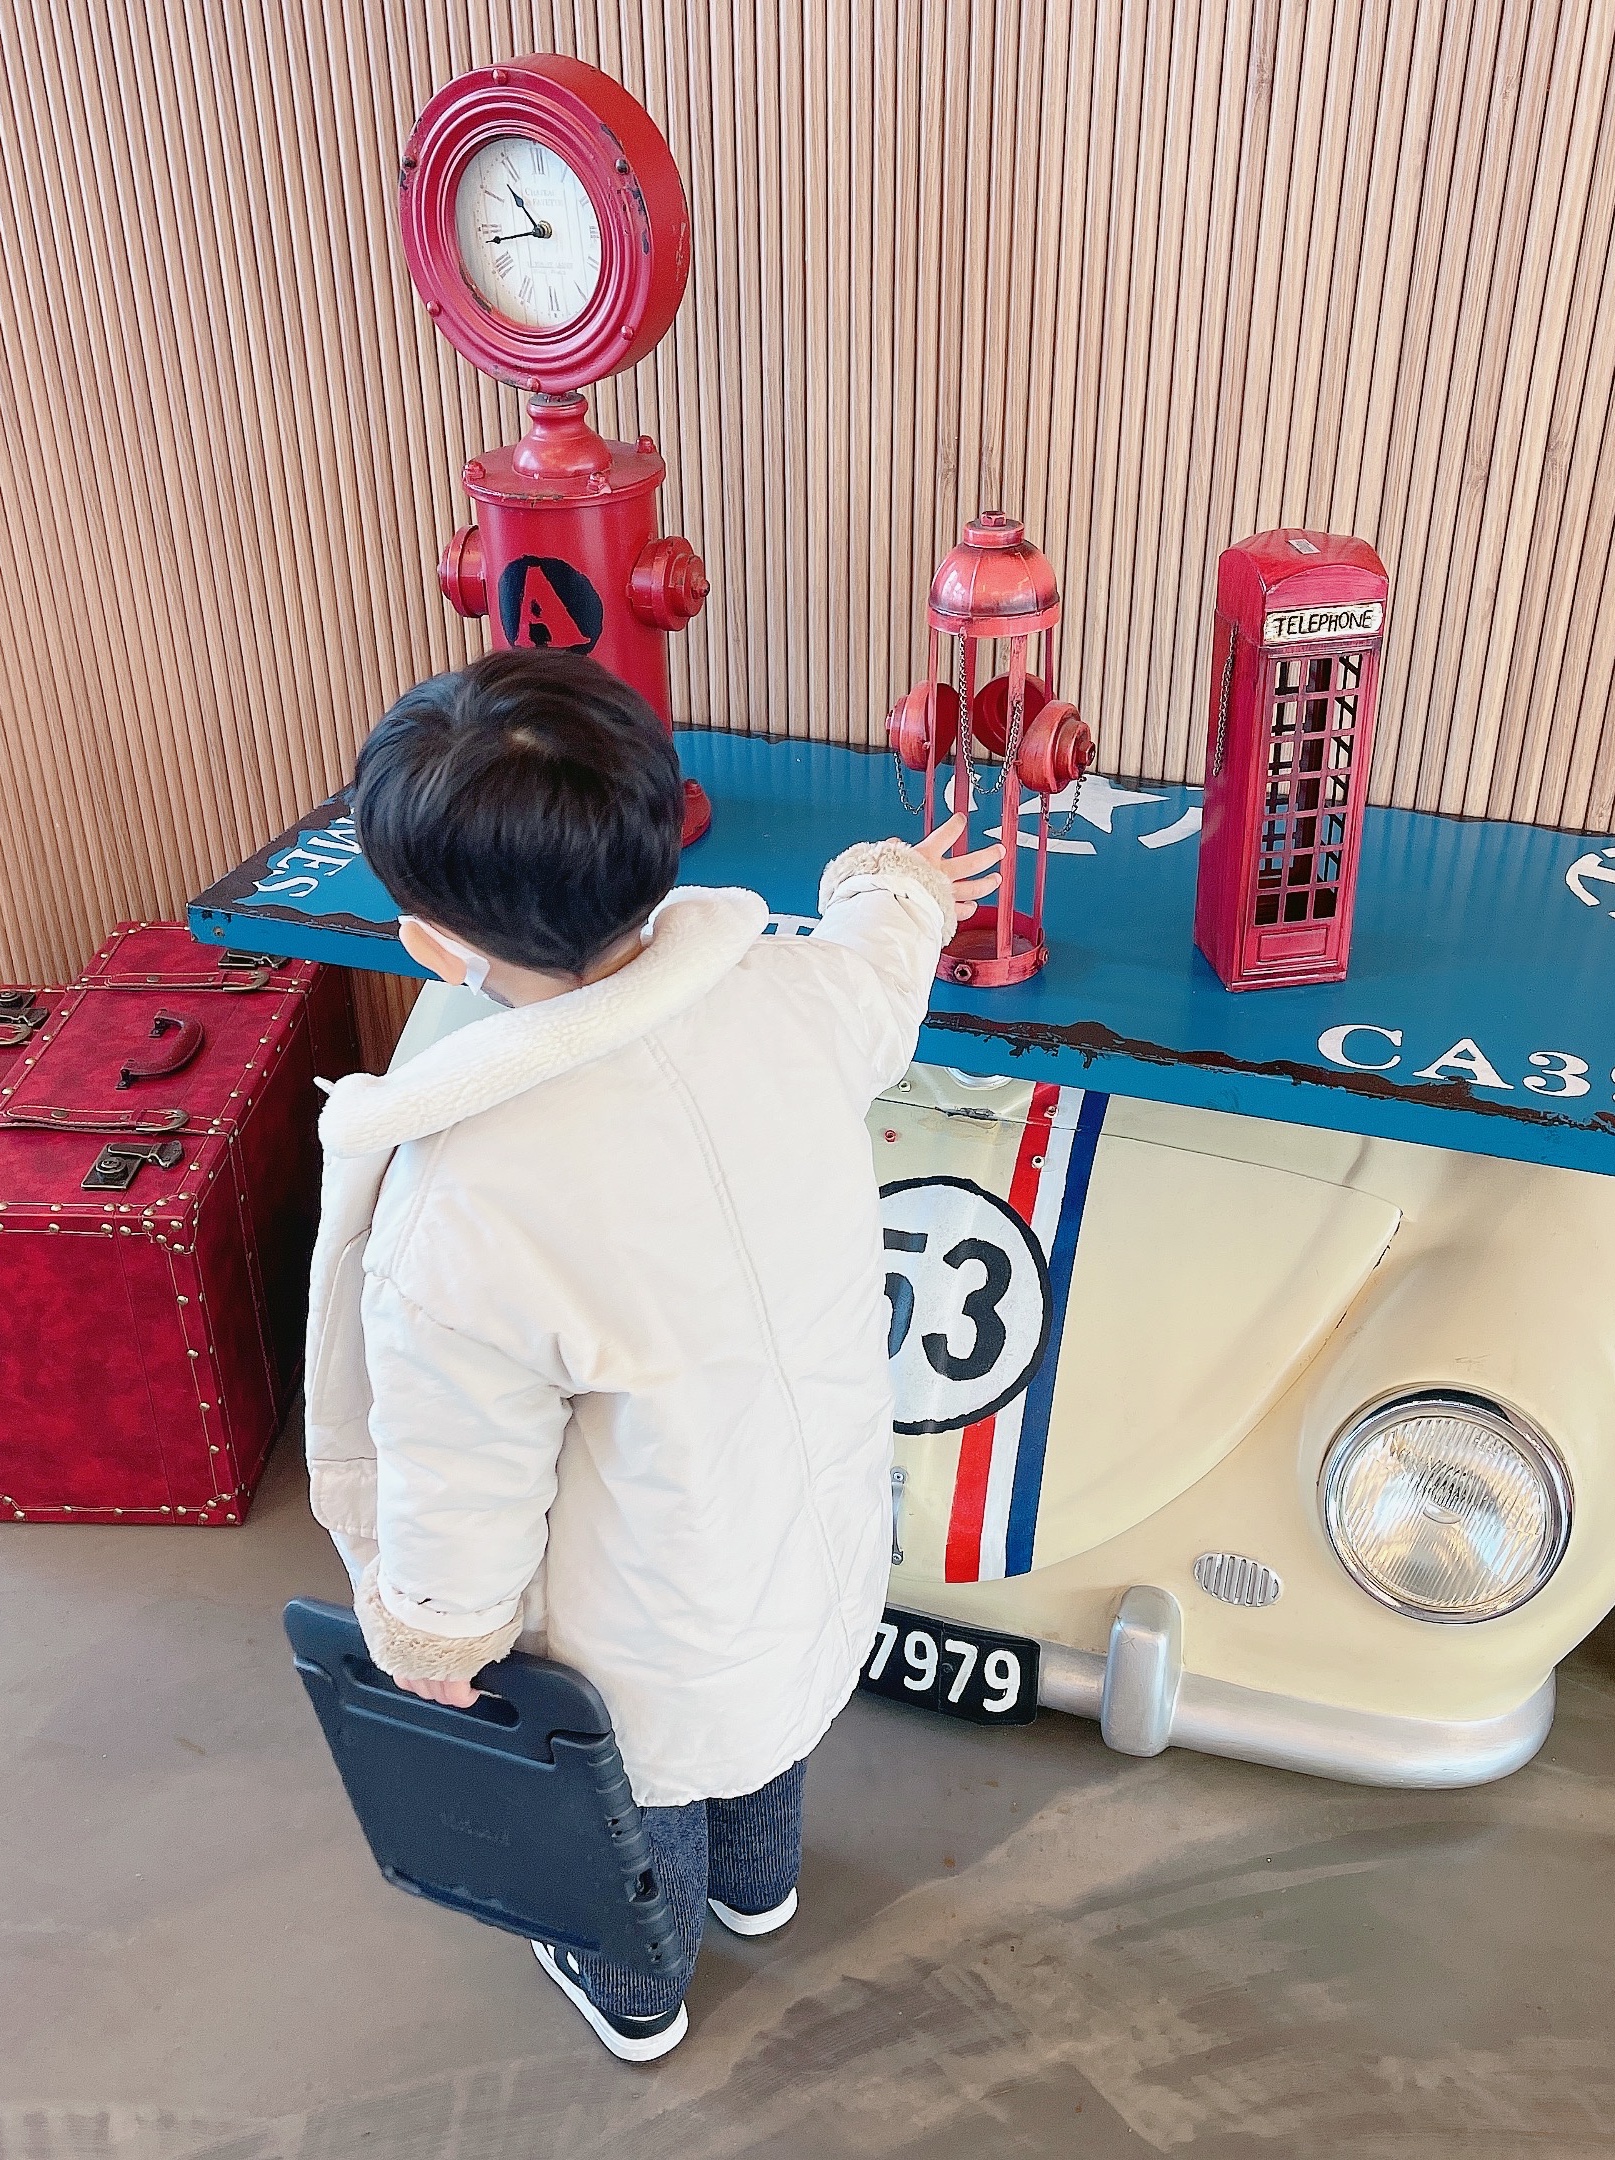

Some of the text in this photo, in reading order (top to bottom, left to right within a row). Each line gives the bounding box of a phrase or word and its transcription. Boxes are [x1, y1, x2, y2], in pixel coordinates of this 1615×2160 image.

[513, 565, 592, 648] A
[1274, 609, 1374, 637] TELEPHONE
[1317, 1023, 1615, 1103] CA3
[868, 1622, 1021, 1713] 7979
